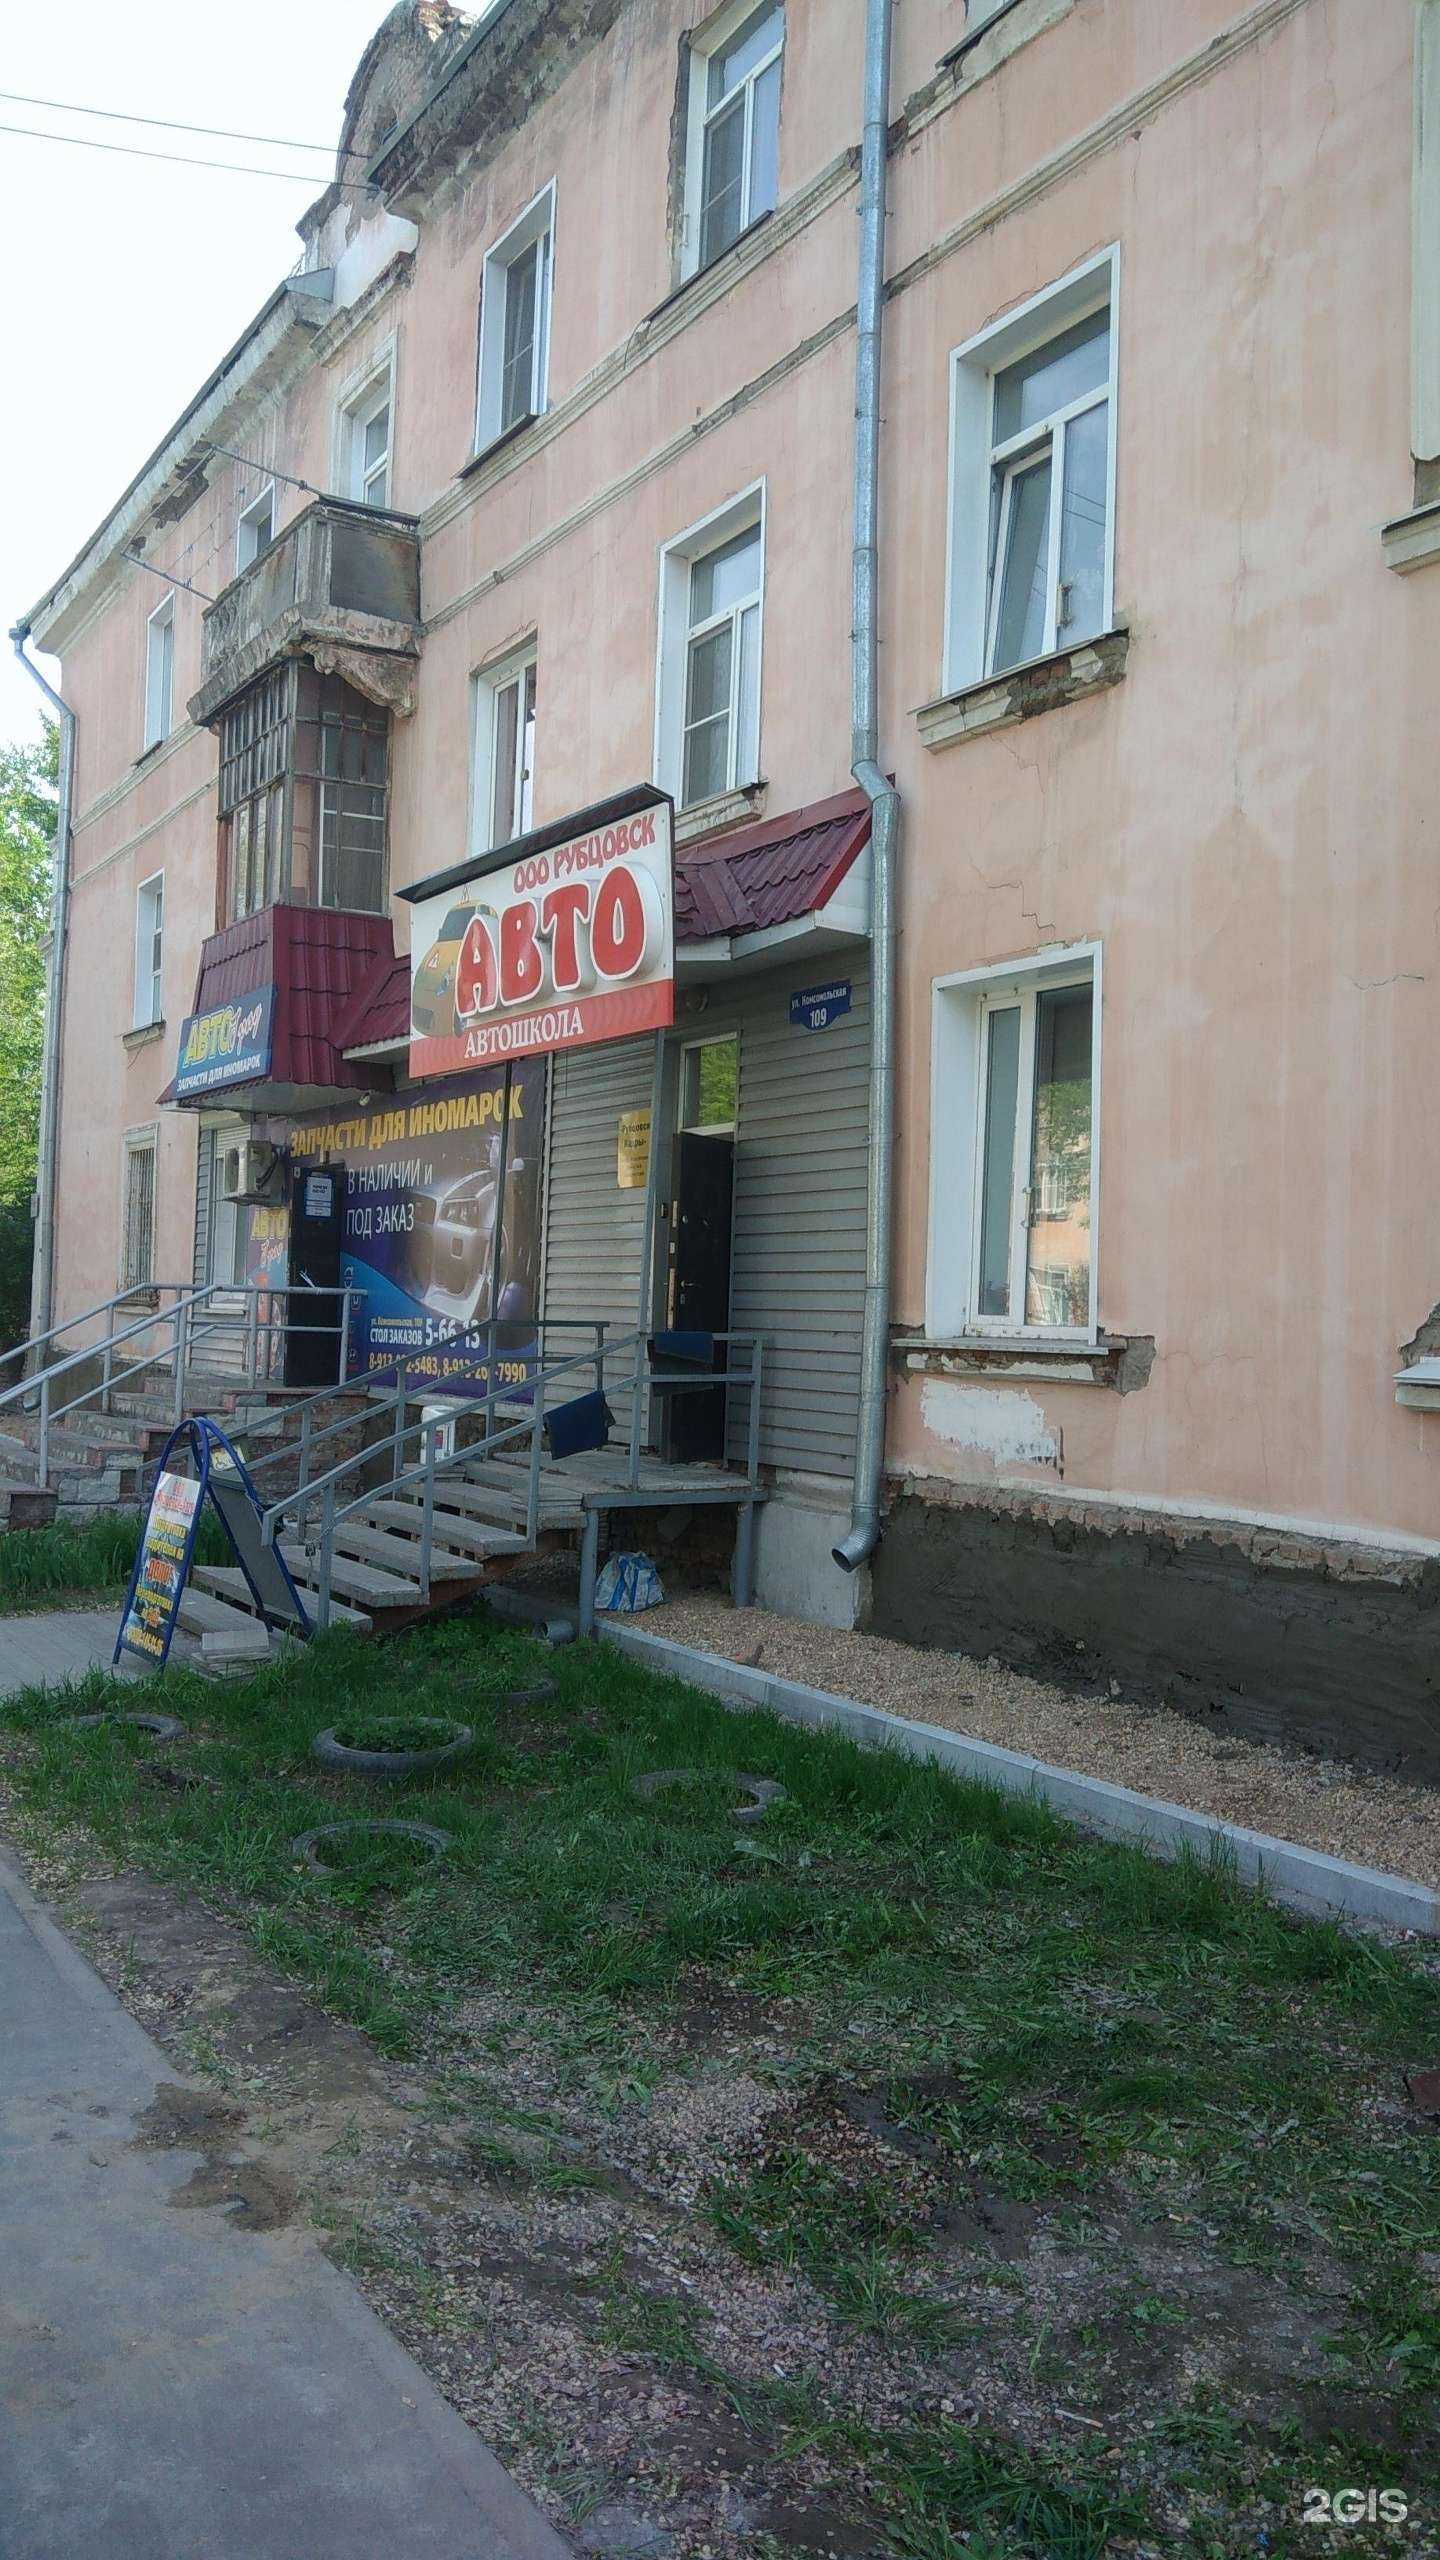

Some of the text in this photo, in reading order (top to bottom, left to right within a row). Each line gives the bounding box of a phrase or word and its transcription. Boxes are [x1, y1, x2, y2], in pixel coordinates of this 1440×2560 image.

[513, 813, 656, 894] ООО РУБЦОВСК
[455, 865, 647, 1018] АВТО
[801, 987, 847, 1007] Комсомольская
[464, 1006, 585, 1059] АВТОШКОЛА
[809, 1008, 828, 1028] 109
[290, 1117, 367, 1158] ЗАПЧАСТИ
[368, 1109, 406, 1150] ДЛЯ
[348, 1169, 356, 1194] В
[359, 1158, 422, 1193] НАЛИЧИИ
[346, 1202, 415, 1240] ПОД ЗАКАЗ
[370, 1328, 389, 1344] СТОЛ
[389, 1329, 423, 1345] ЗАКАЗОВ
